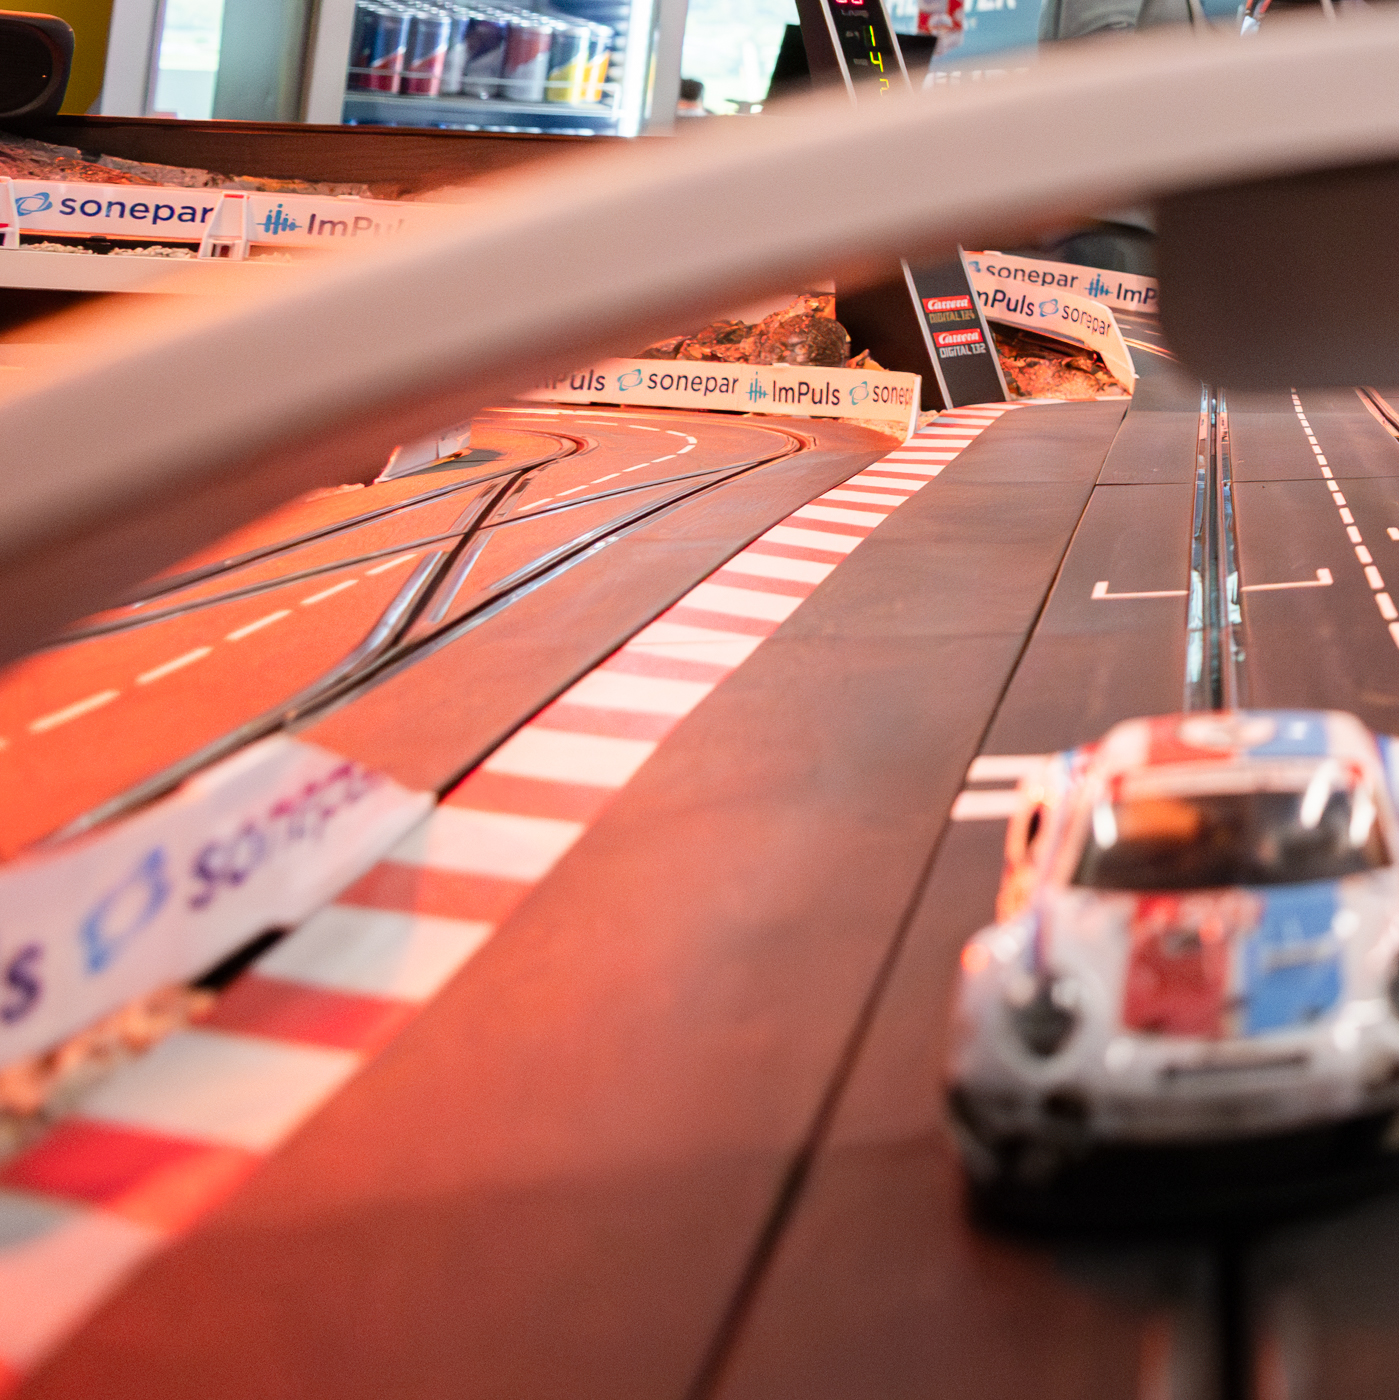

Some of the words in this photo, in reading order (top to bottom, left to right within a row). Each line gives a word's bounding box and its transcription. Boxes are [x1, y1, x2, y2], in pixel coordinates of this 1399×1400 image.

[869, 24, 877, 47] 1
[869, 50, 884, 73] 4
[59, 196, 213, 226] sonepar
[986, 265, 1079, 289] sonepar
[1116, 282, 1157, 305] ImP
[927, 298, 969, 311] Carrera
[976, 288, 1035, 317] mPuls
[938, 331, 979, 345] Carrera
[939, 344, 971, 359] DIGITAL
[970, 342, 987, 355] 132
[537, 369, 606, 392] Puls
[647, 372, 739, 397] sonepar
[772, 379, 841, 406] ImPuls
